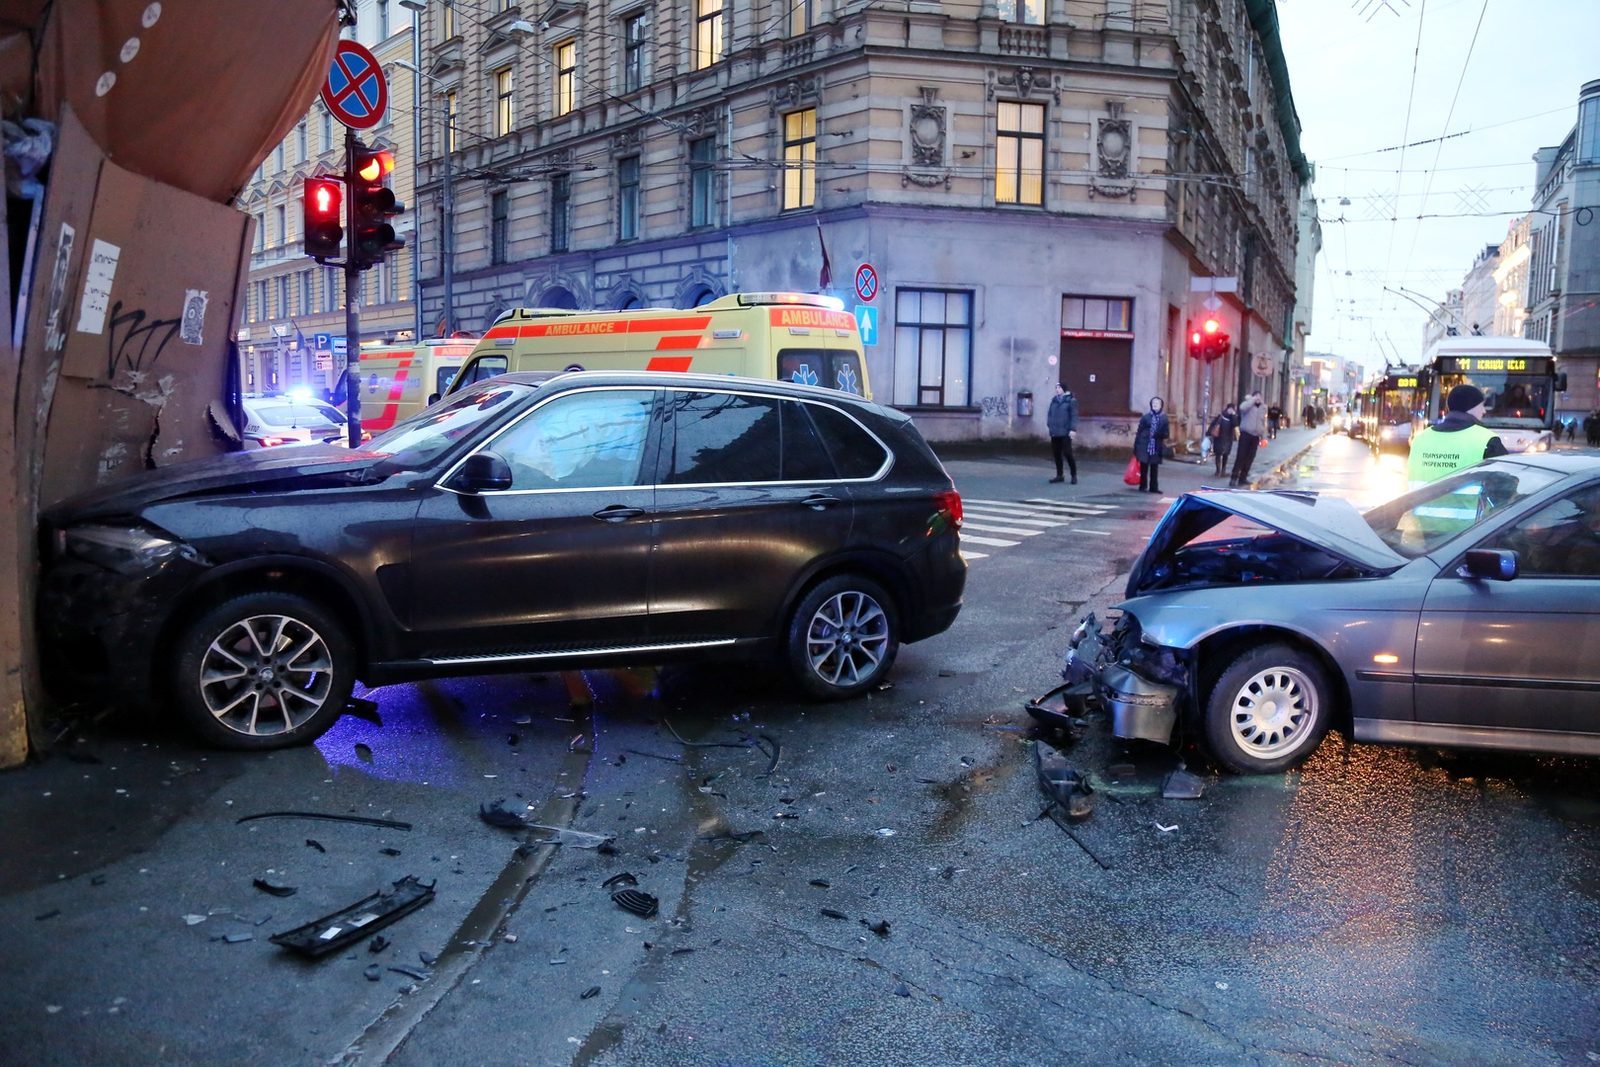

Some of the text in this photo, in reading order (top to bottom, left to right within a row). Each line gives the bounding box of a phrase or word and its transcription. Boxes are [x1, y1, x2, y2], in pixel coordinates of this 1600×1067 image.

[782, 309, 850, 329] AMBULANCE
[545, 322, 614, 336] AMBULANCE
[317, 335, 328, 349] P
[1422, 452, 1460, 460] TRANSPORTA
[1422, 460, 1457, 468] INSPEKTORS
